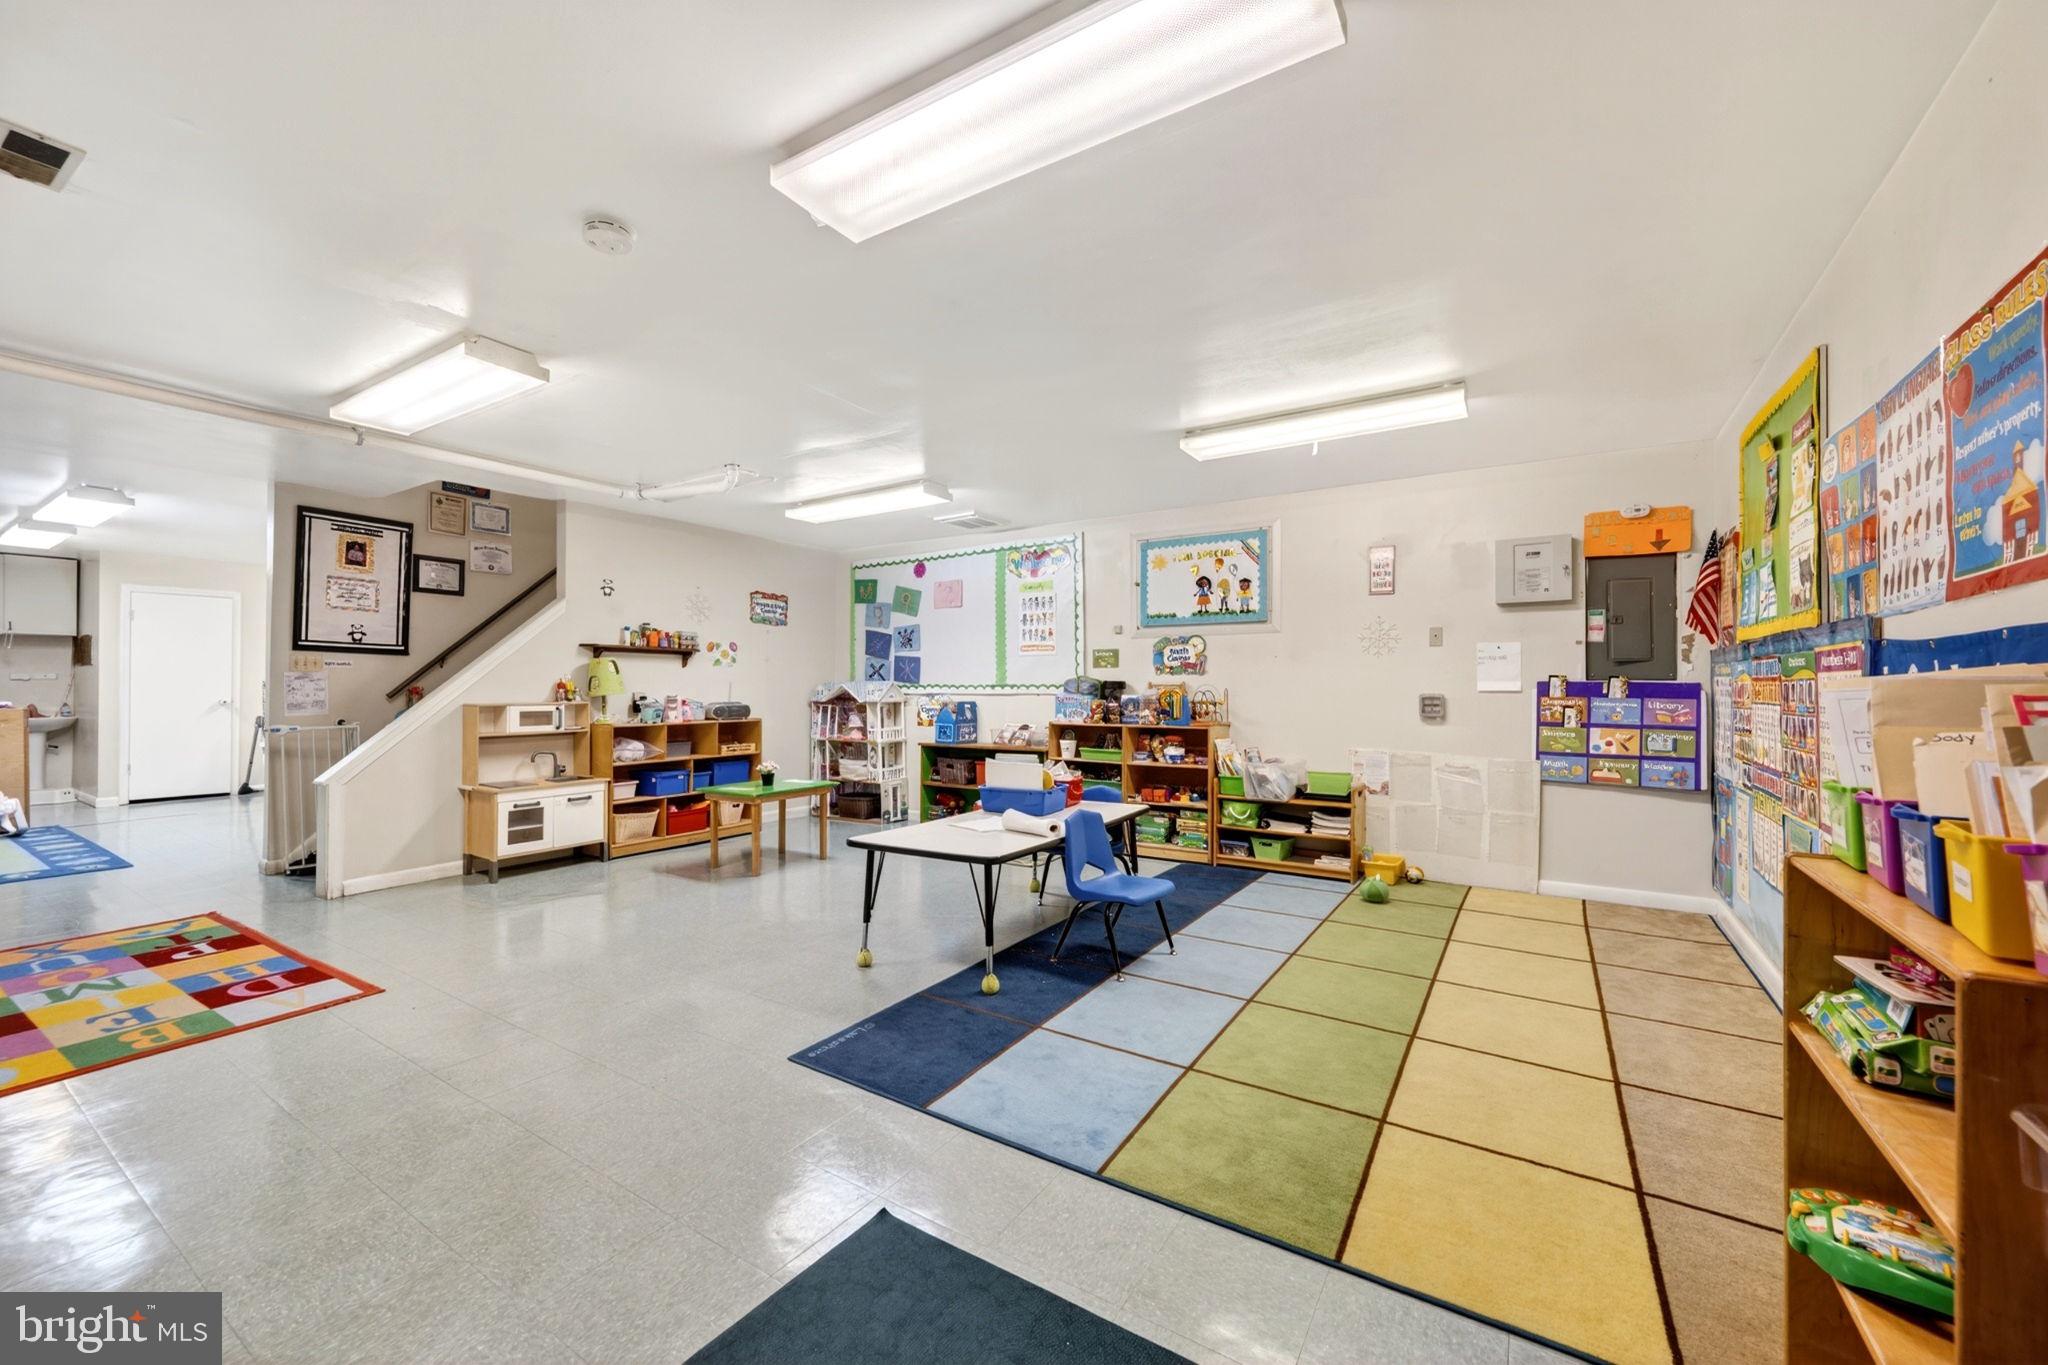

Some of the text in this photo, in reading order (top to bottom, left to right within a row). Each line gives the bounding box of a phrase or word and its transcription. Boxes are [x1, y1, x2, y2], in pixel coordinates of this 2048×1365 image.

[1944, 259, 2048, 374] CLASS RULES
[2002, 400, 2041, 437] property.
[1648, 700, 1686, 711] Library
[86, 973, 306, 1033] D E
[117, 1022, 201, 1050] B
